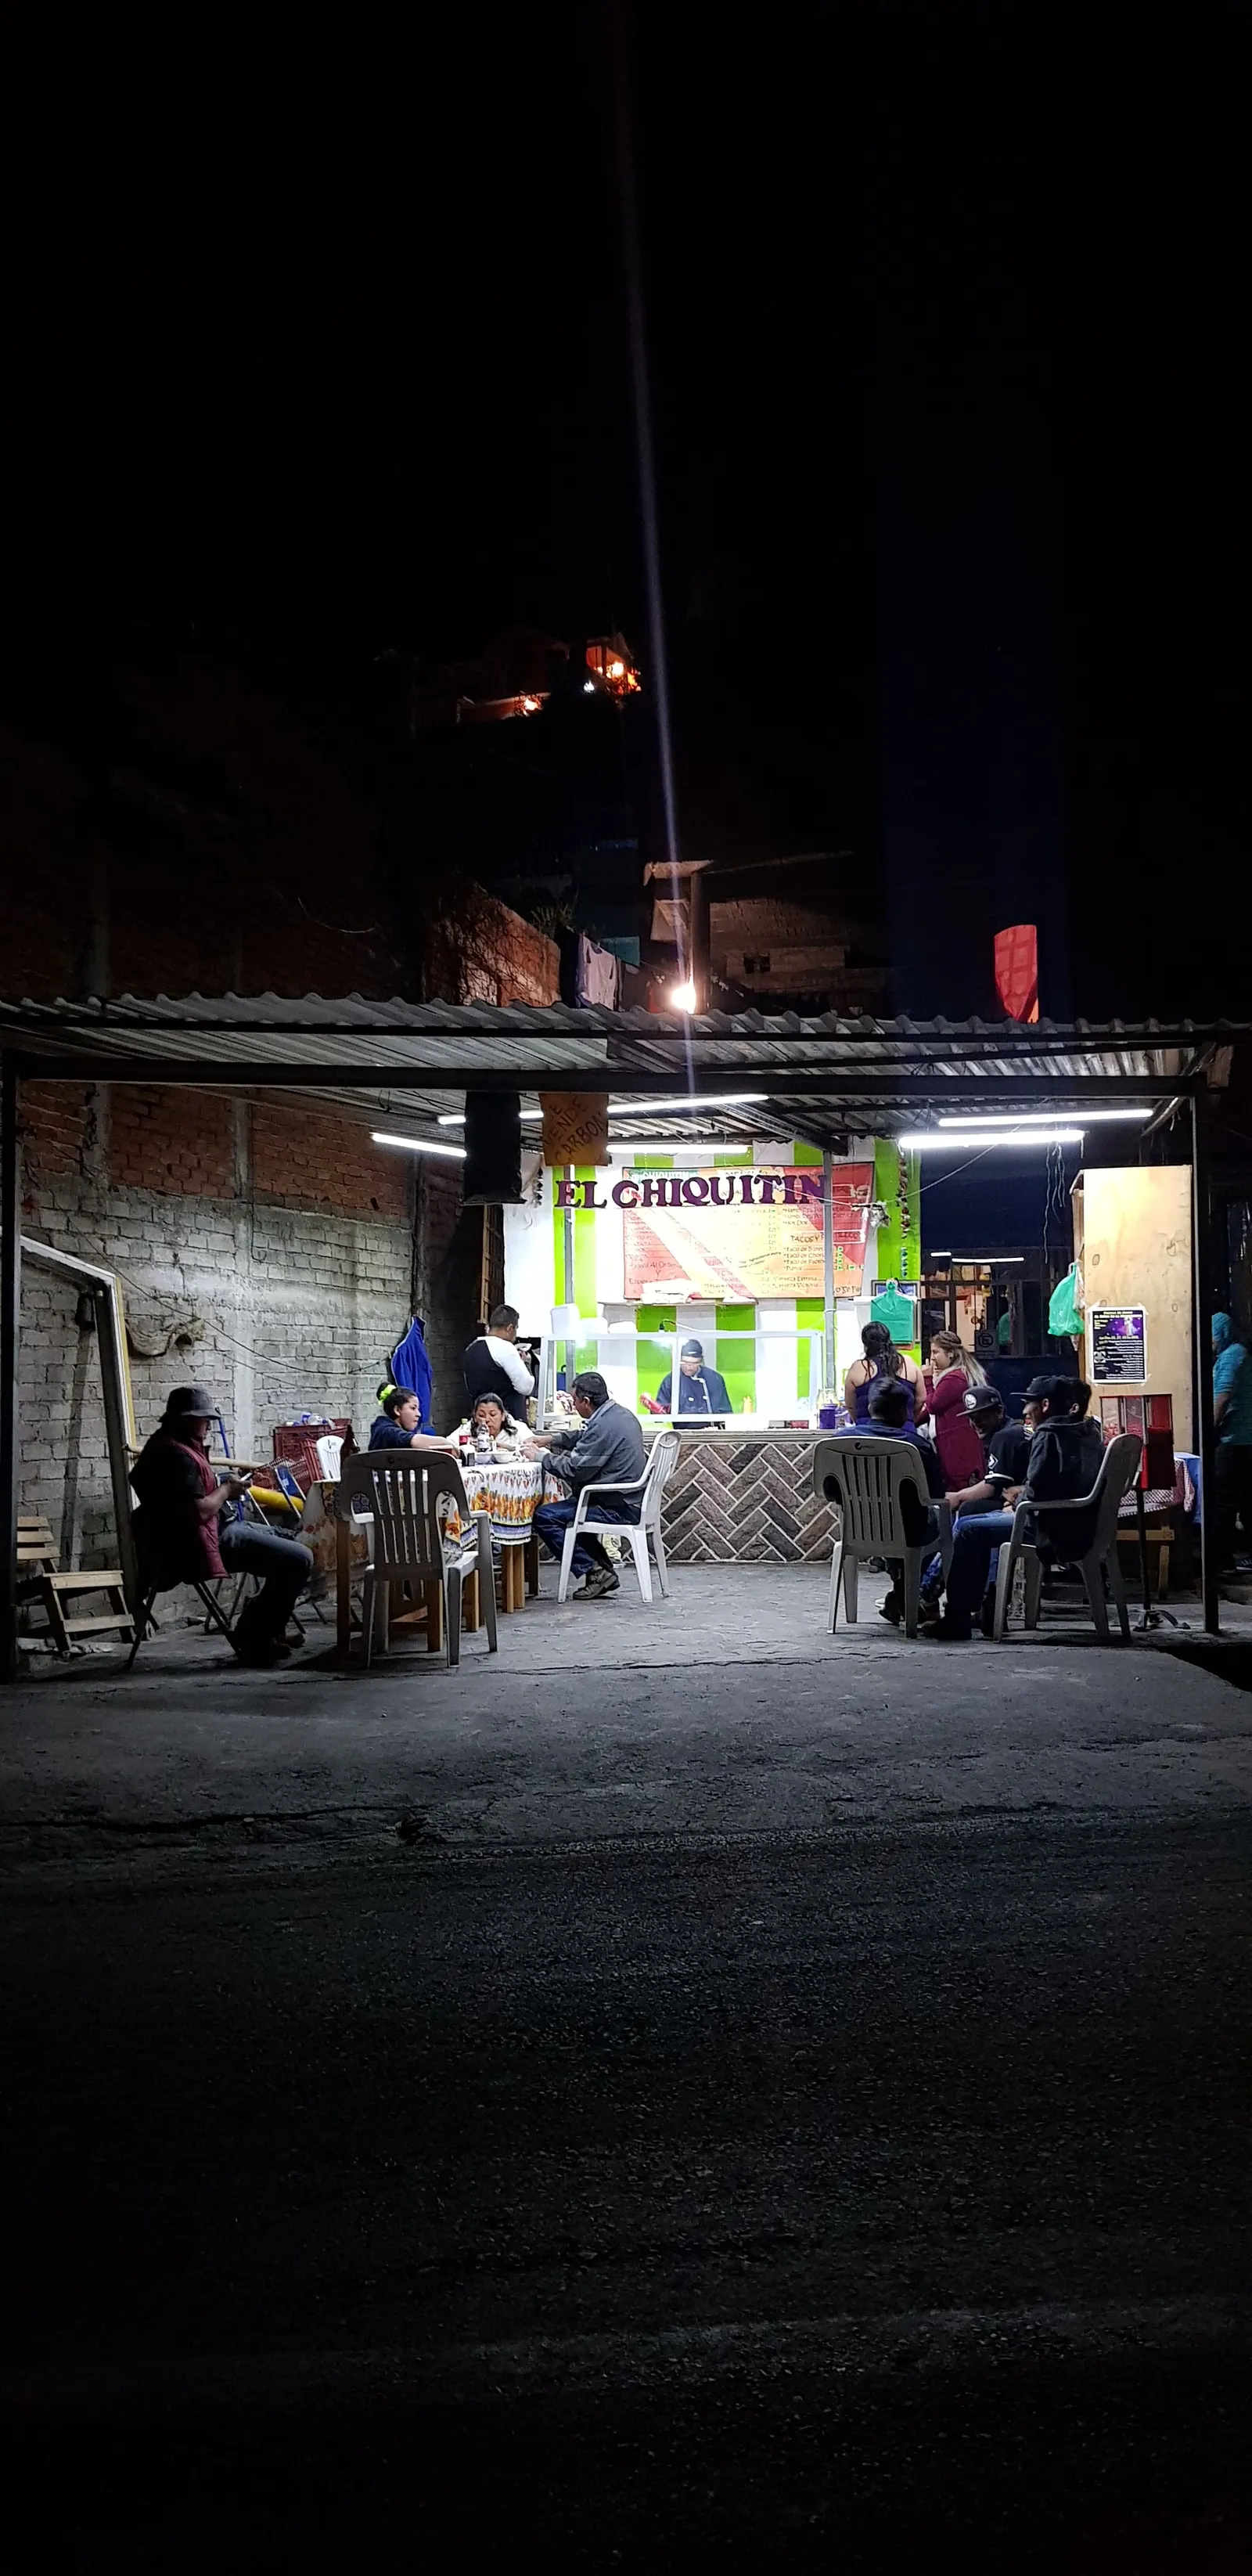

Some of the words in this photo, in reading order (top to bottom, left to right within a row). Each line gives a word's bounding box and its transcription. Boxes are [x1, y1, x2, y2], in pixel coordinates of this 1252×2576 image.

[554, 1180, 607, 1209] EL
[611, 1174, 827, 1208] CHIQUITIN
[790, 1234, 814, 1243] TACOS
